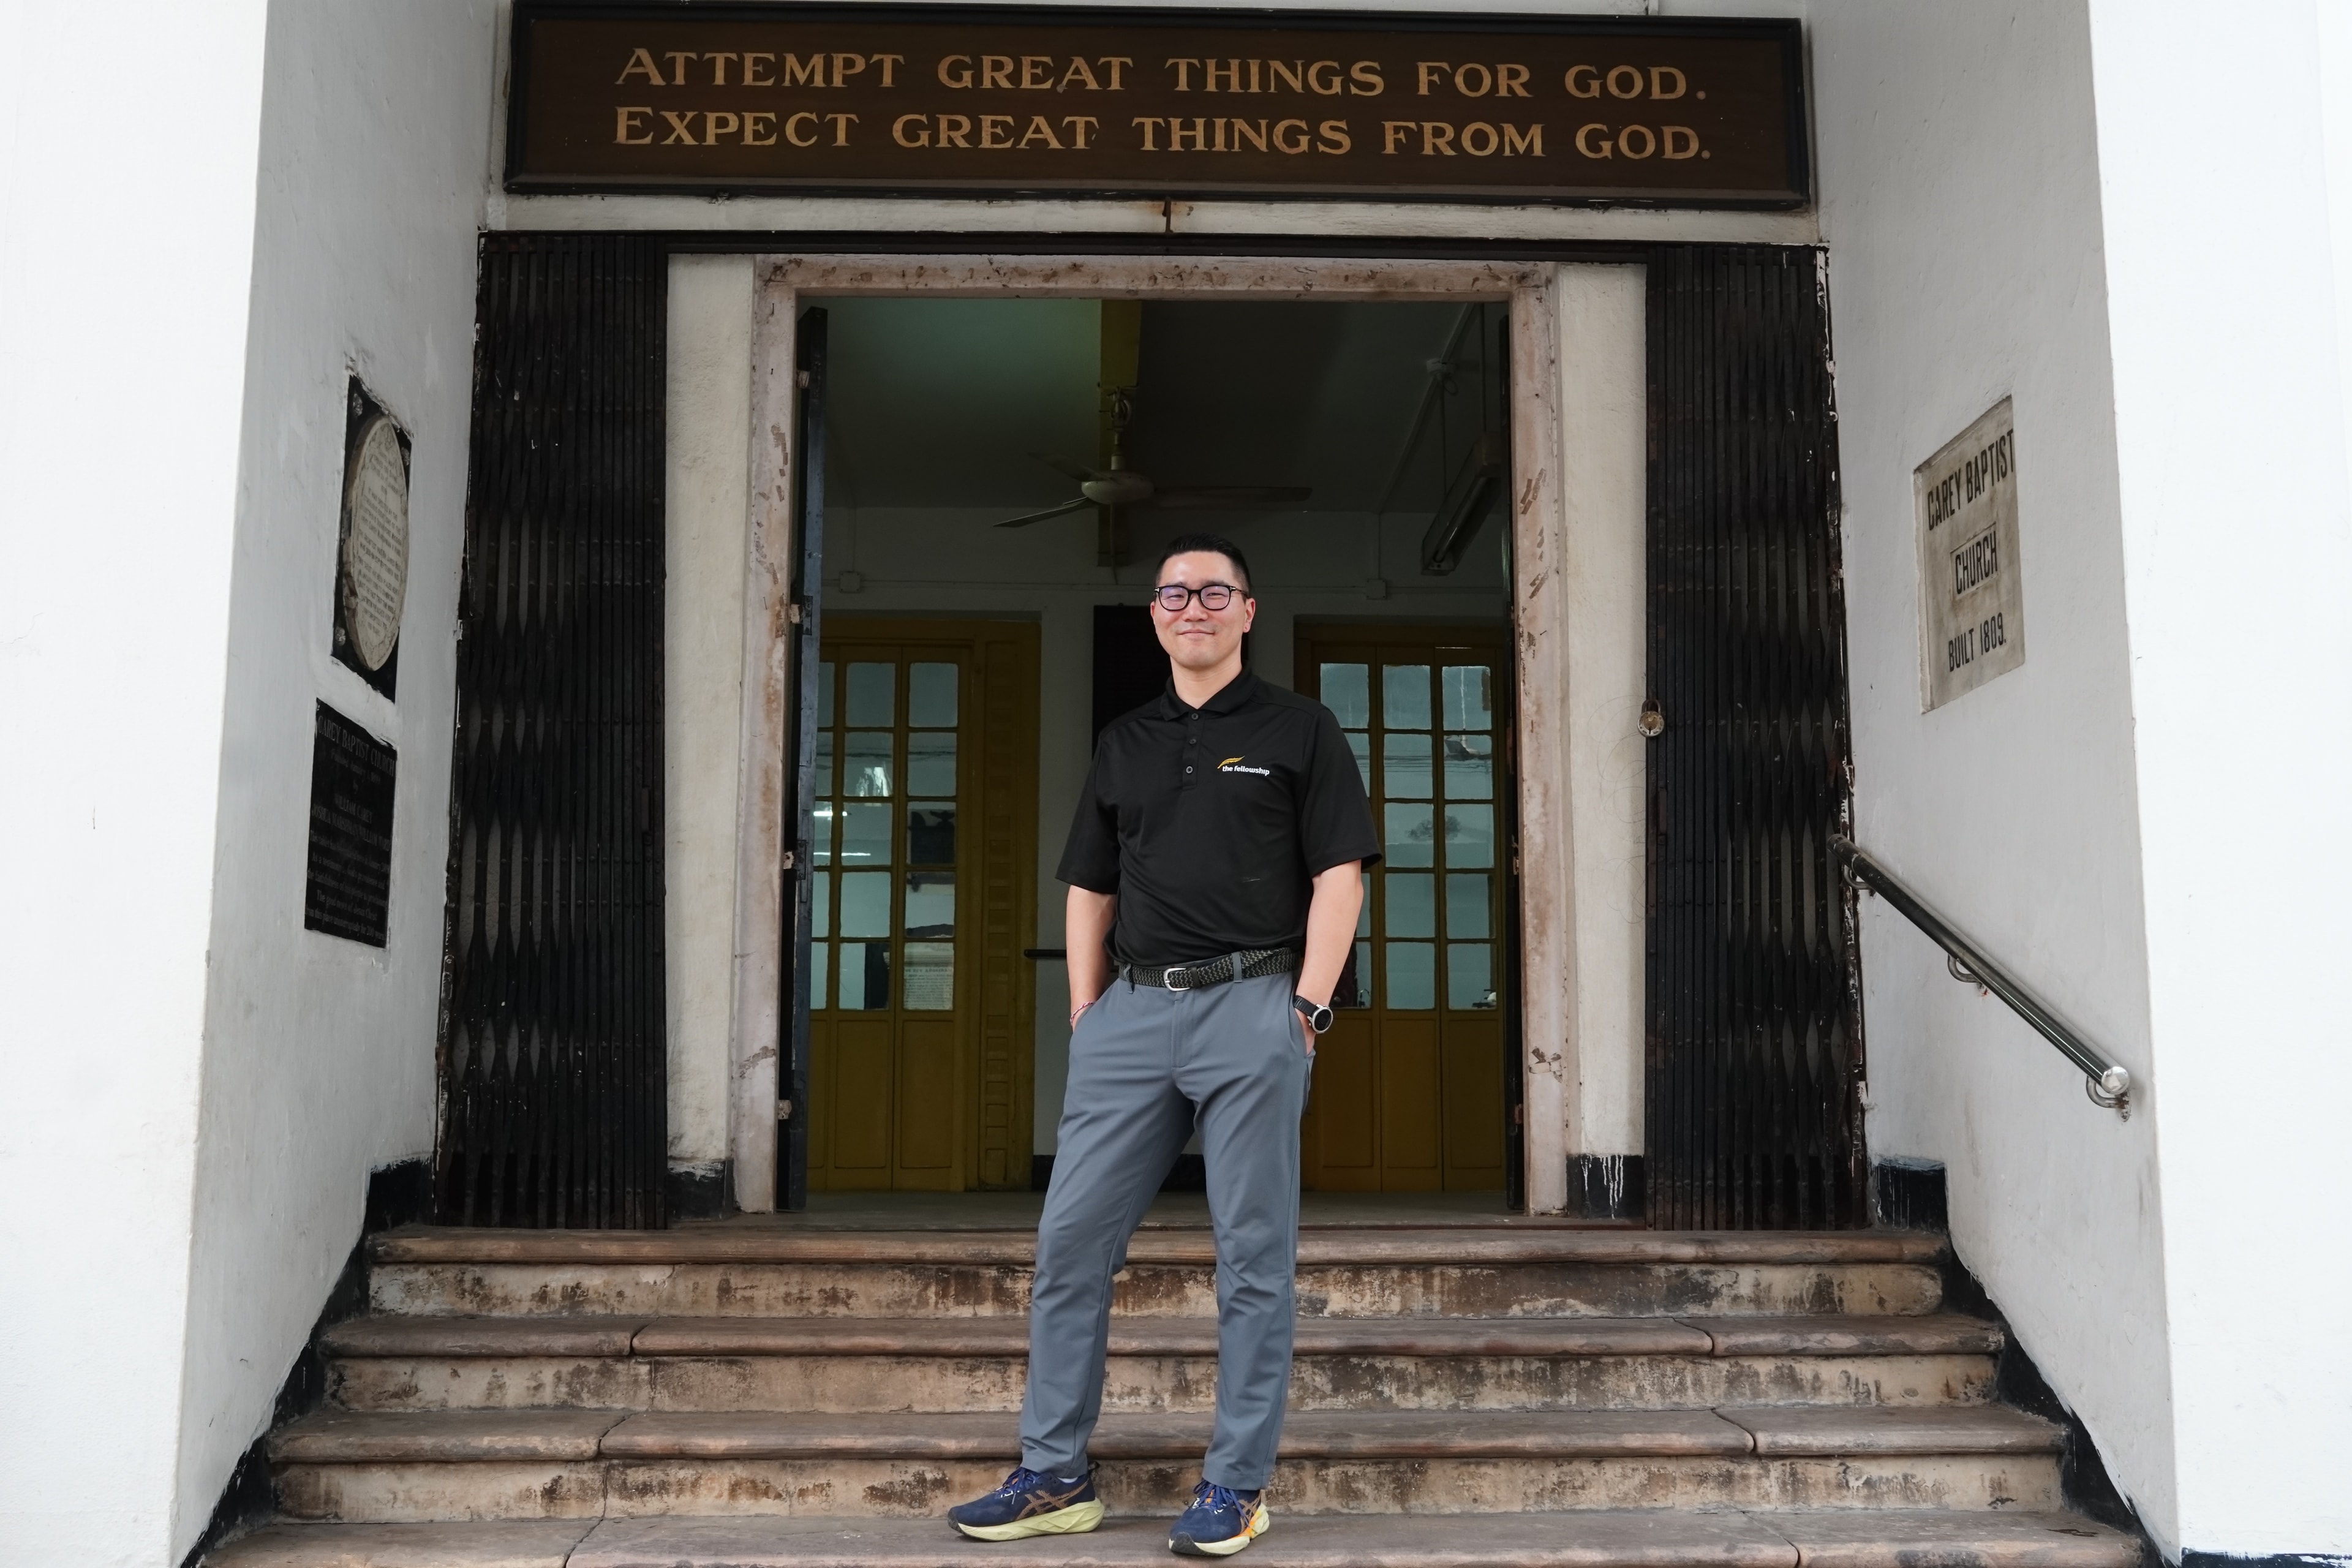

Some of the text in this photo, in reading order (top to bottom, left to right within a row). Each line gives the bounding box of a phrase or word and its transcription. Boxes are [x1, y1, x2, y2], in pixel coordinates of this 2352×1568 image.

[616, 47, 1707, 102] ATTEMPT GREAT THINGS FOR GOD.
[614, 105, 1712, 161] EXPECT GREAT THINGS FROM GOD.
[1927, 428, 2014, 531] CAREY BAPTIST
[1954, 531, 1997, 594] CHURCH
[1948, 612, 2007, 672] BUILT 1809.
[317, 715, 341, 744] CAREY
[342, 729, 369, 761] BAPTIST
[371, 748, 395, 777] CHURCH
[1234, 766, 1270, 776] fellowship
